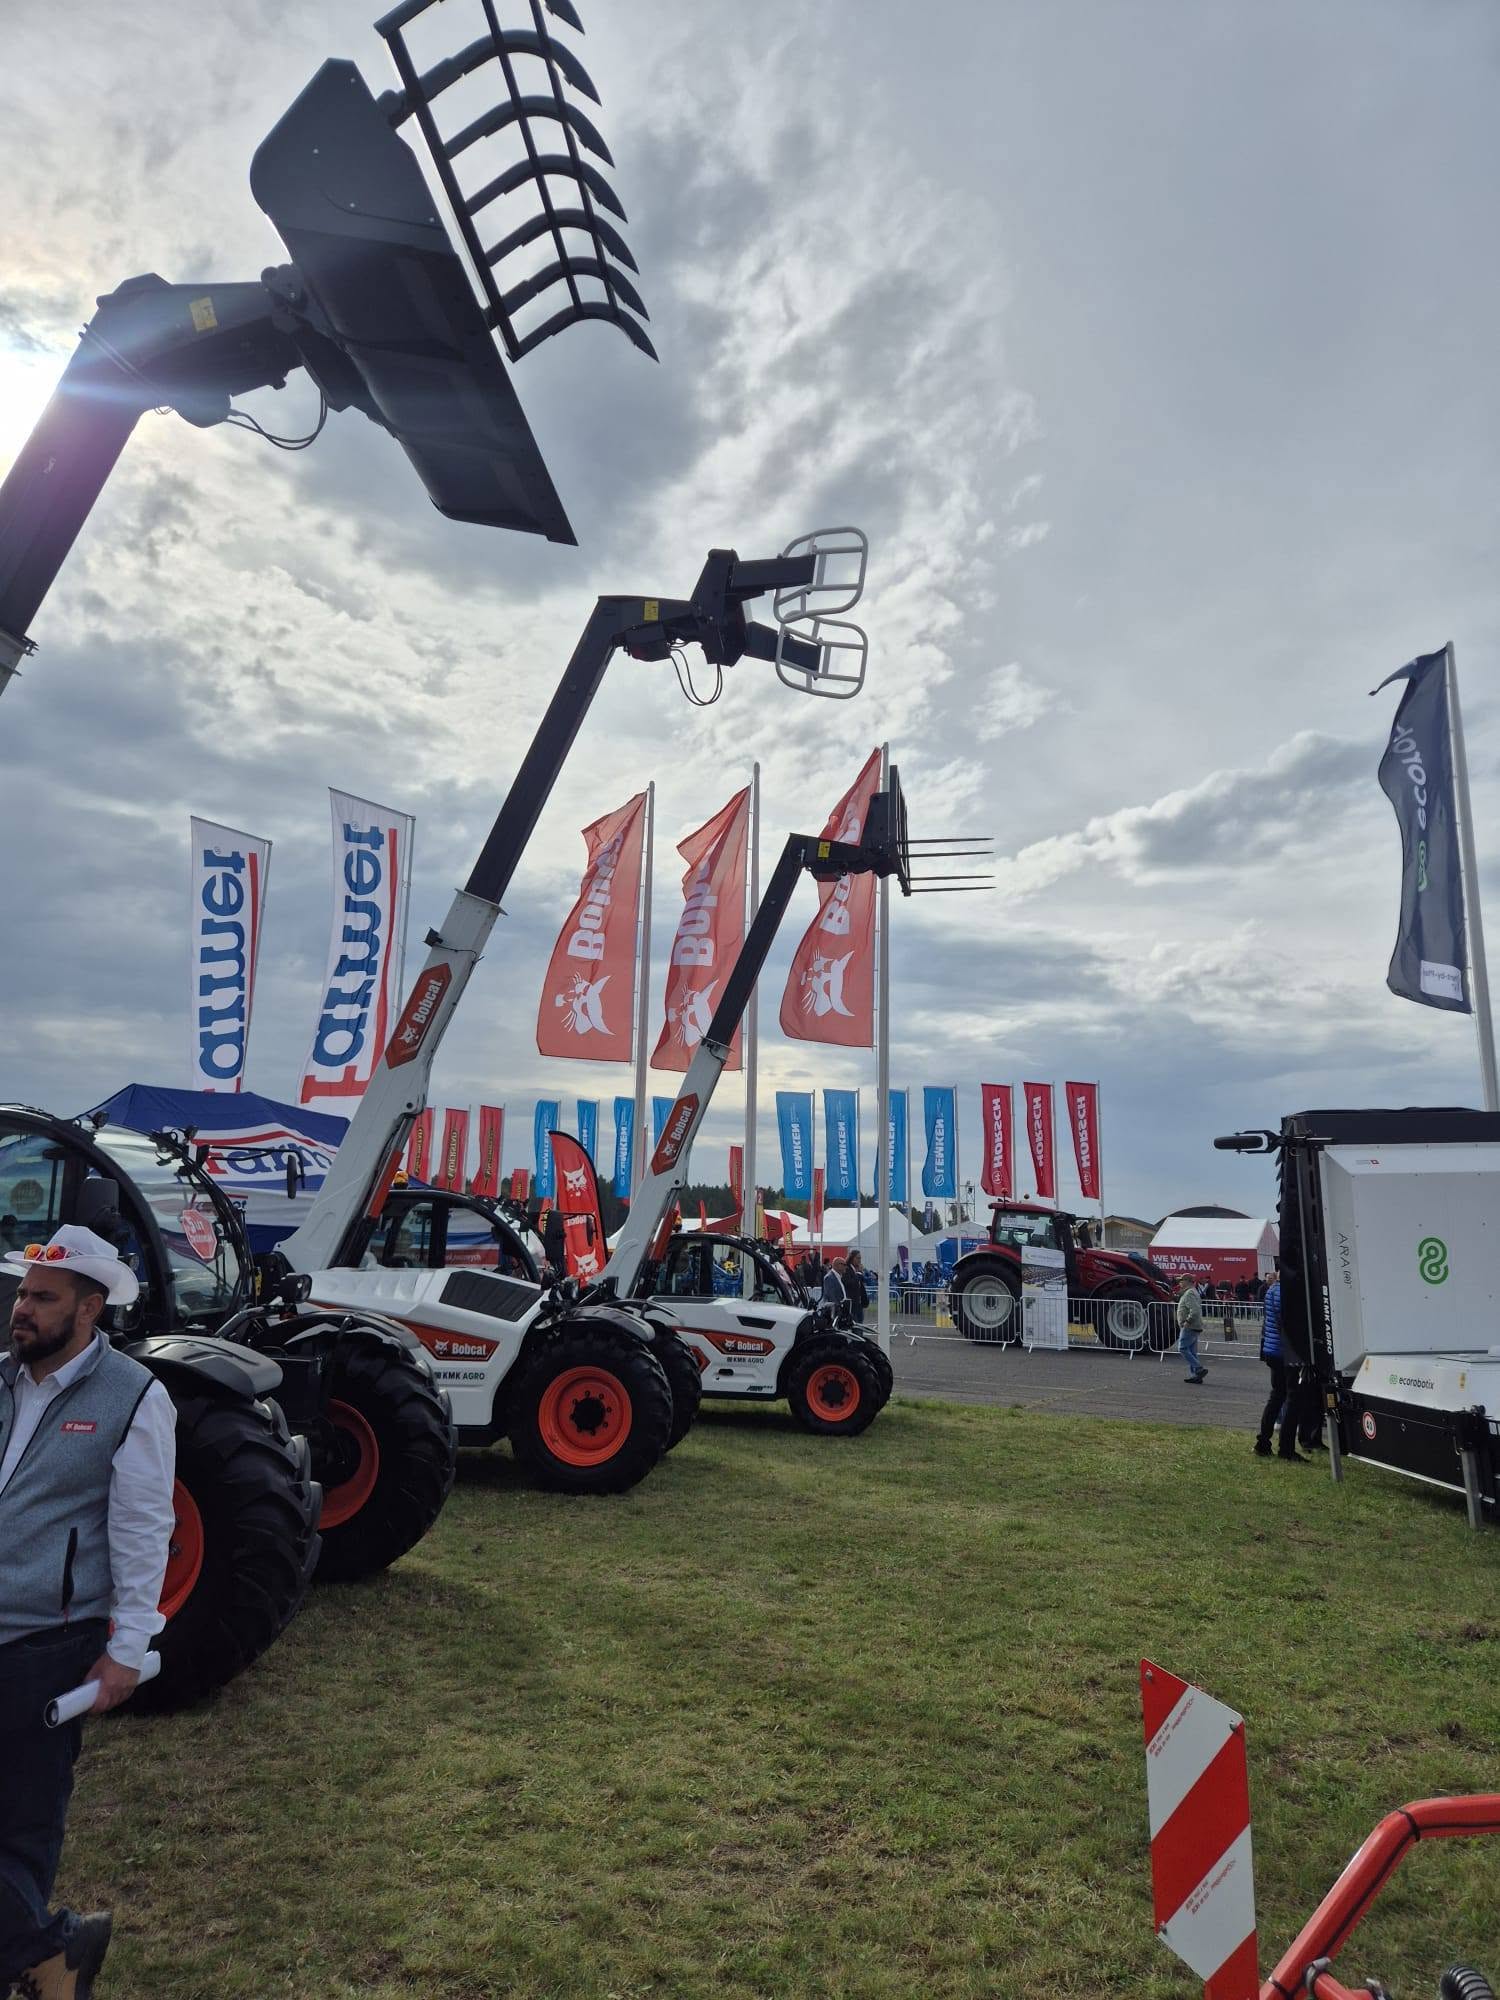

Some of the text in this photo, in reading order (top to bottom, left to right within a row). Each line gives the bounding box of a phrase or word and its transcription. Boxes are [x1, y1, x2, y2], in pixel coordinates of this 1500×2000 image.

[412, 980, 442, 1024] Bobcat
[671, 1105, 692, 1140] Bobcat
[1338, 1232, 1351, 1268] ARA
[1152, 1254, 1196, 1263] WE WILL
[1179, 1262, 1187, 1270] A
[1188, 1262, 1214, 1271] WAY.
[737, 1341, 764, 1351] Bobcat
[1325, 1323, 1333, 1355] AGRO
[452, 1342, 487, 1356] Bobcat
[442, 1371, 485, 1380] KMK AGRO
[1398, 1376, 1434, 1390] ecorobotix
[73, 1423, 93, 1431] Bobcat
